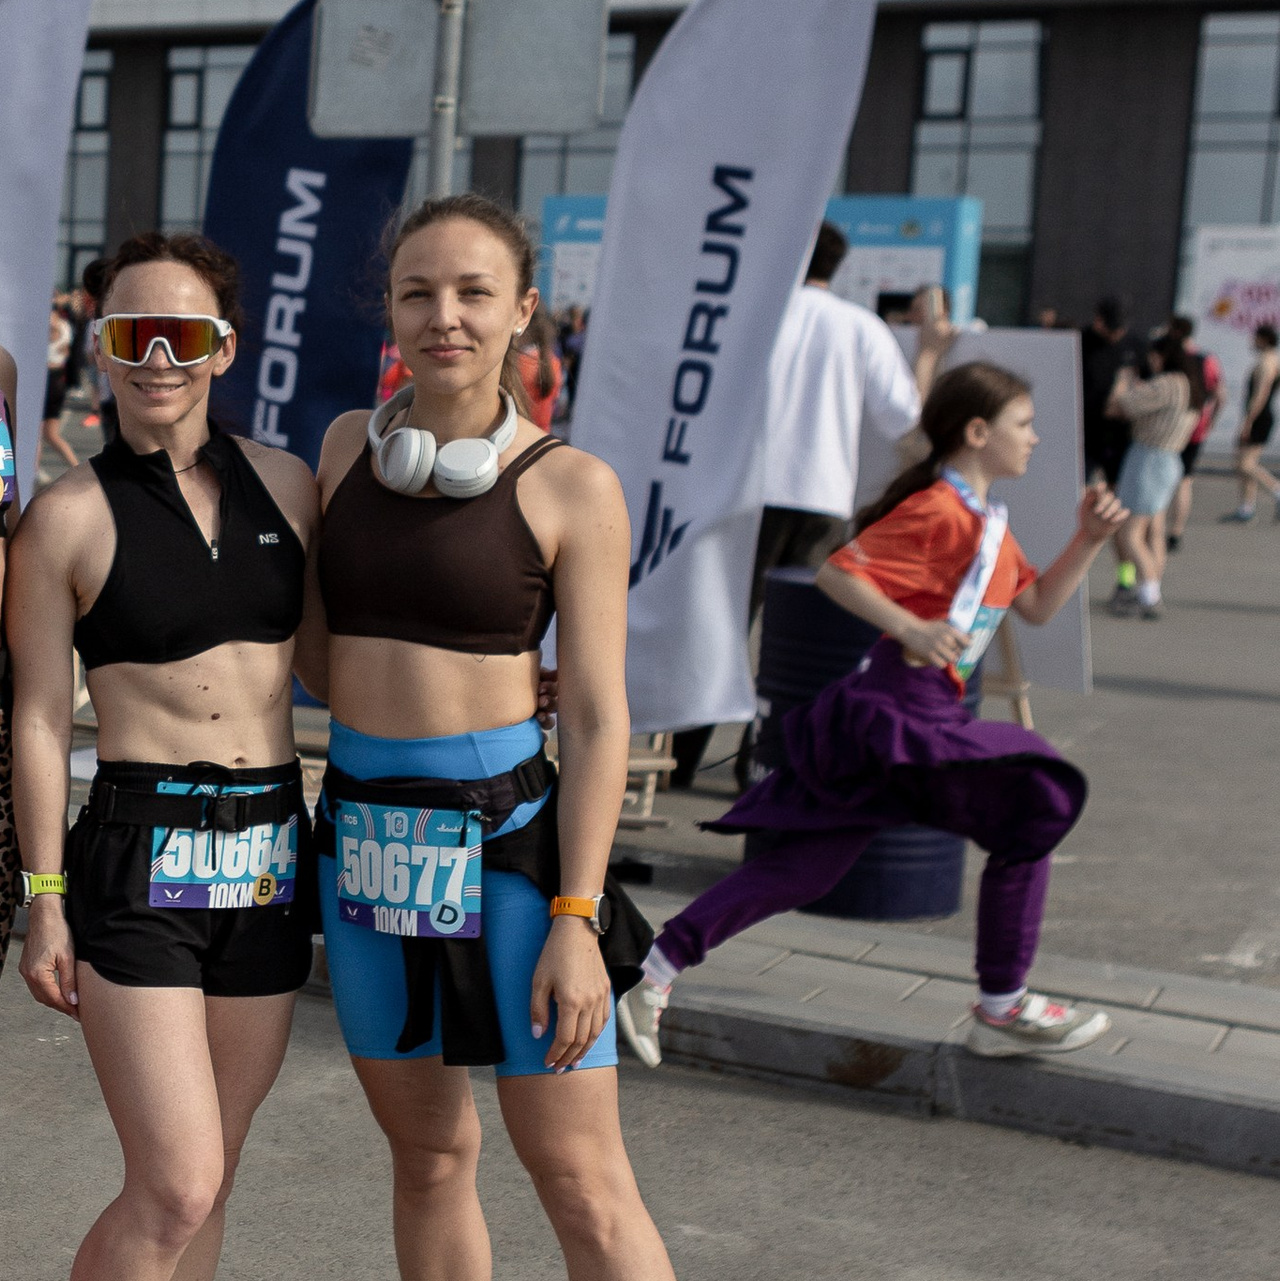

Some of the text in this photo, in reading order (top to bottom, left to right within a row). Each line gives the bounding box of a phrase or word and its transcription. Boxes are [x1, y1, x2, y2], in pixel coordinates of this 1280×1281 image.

[252, 167, 326, 449] FORUM
[662, 165, 754, 466] FORUM
[162, 823, 291, 879] 50664
[342, 836, 470, 906] 50677
[207, 882, 254, 909] 10KM
[258, 878, 272, 897] B
[373, 905, 418, 937] 10KM
[436, 904, 459, 925] D
